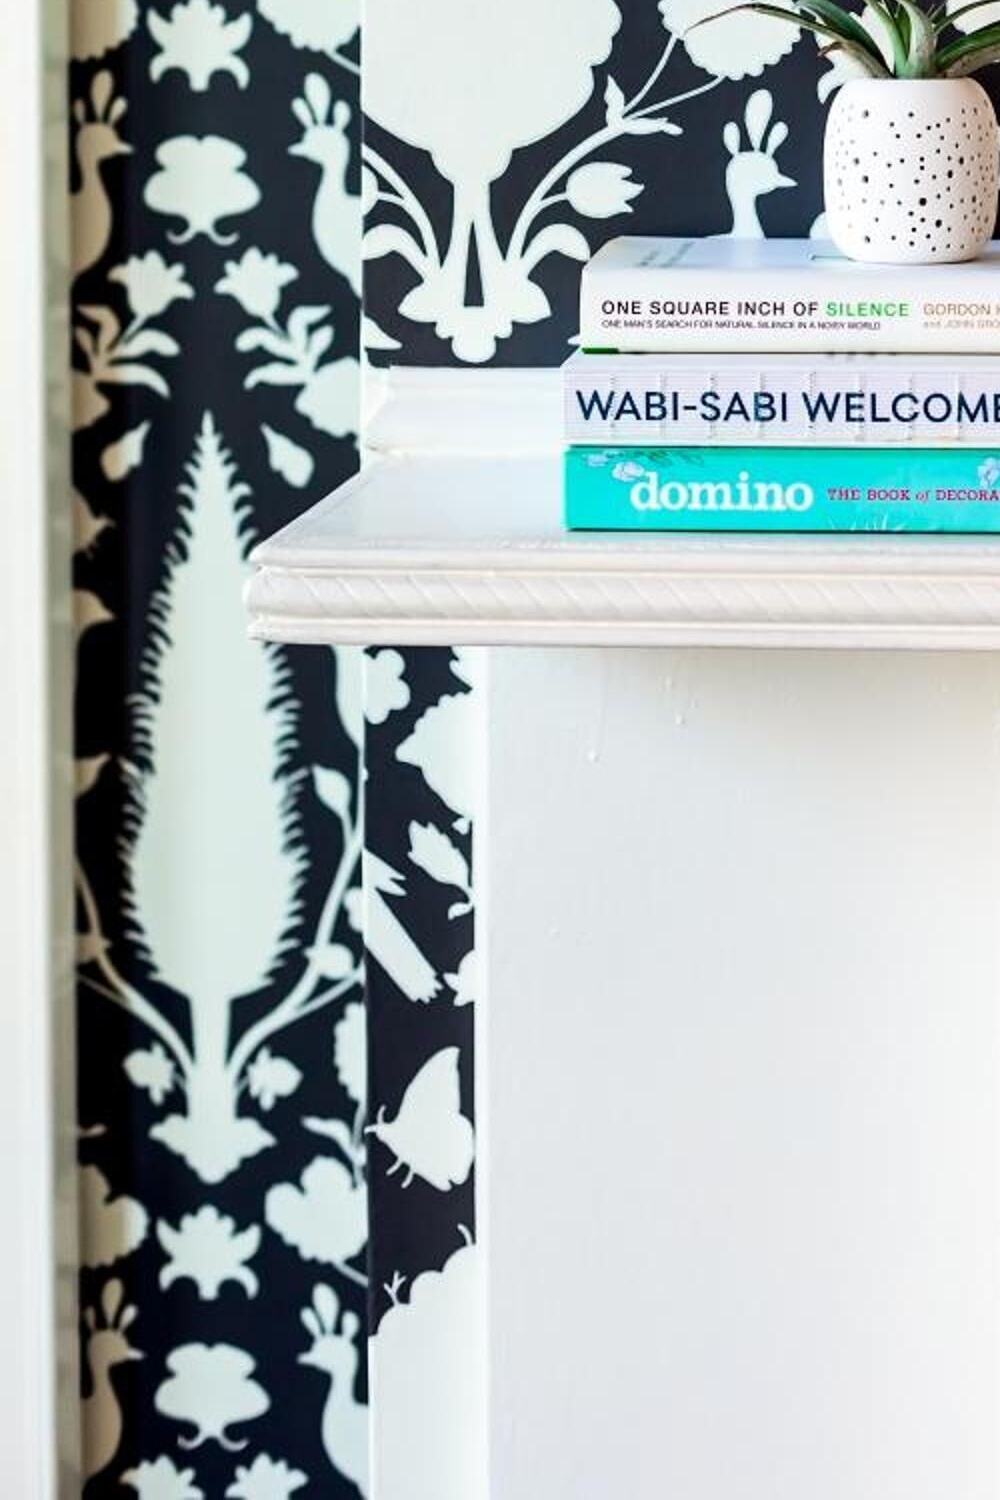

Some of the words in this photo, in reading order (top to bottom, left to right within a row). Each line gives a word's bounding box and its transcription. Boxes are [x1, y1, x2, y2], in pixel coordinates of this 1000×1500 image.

[602, 300, 641, 315] ONE
[650, 300, 729, 315] SQUARE
[738, 301, 785, 316] INCH
[793, 302, 818, 317] OF
[825, 303, 909, 317] SILENCE
[923, 303, 991, 316] GORDON
[601, 320, 621, 329] ONE
[655, 320, 693, 329] SEARCH
[694, 320, 713, 329] FOR
[715, 320, 757, 329] NATURAL
[758, 321, 795, 329] SILENCE
[798, 321, 807, 329] IN
[818, 321, 845, 330] NOISY
[847, 321, 880, 330] WORLD
[944, 320, 975, 330] JOHN
[576, 390, 787, 422] WABI-SABI
[629, 471, 814, 511] domino
[828, 489, 860, 501] THE
[867, 489, 911, 501] BOOK
[916, 489, 930, 503] of
